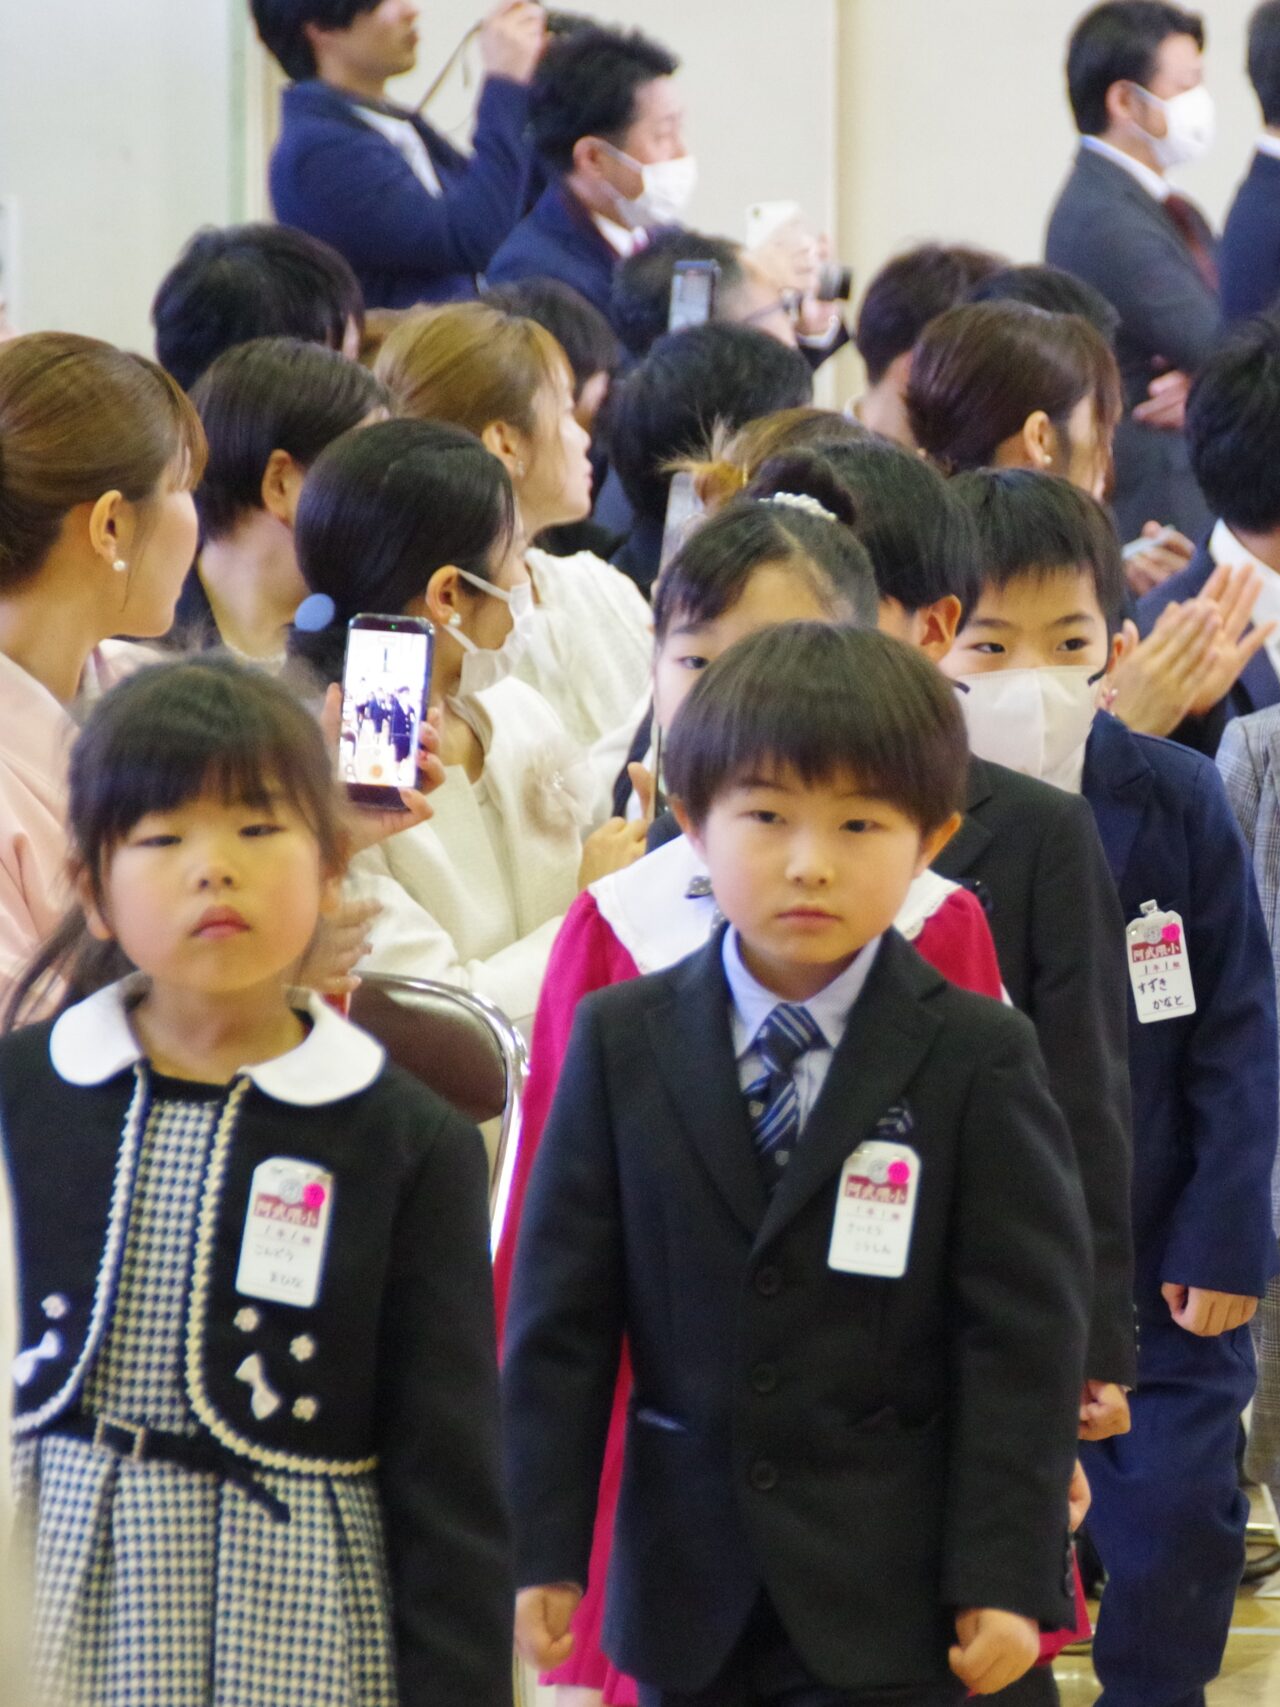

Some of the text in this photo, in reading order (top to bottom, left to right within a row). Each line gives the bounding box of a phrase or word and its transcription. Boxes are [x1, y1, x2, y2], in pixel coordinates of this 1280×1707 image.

[1138, 977, 1167, 995] すずき
[1153, 995, 1184, 1010] かなと
